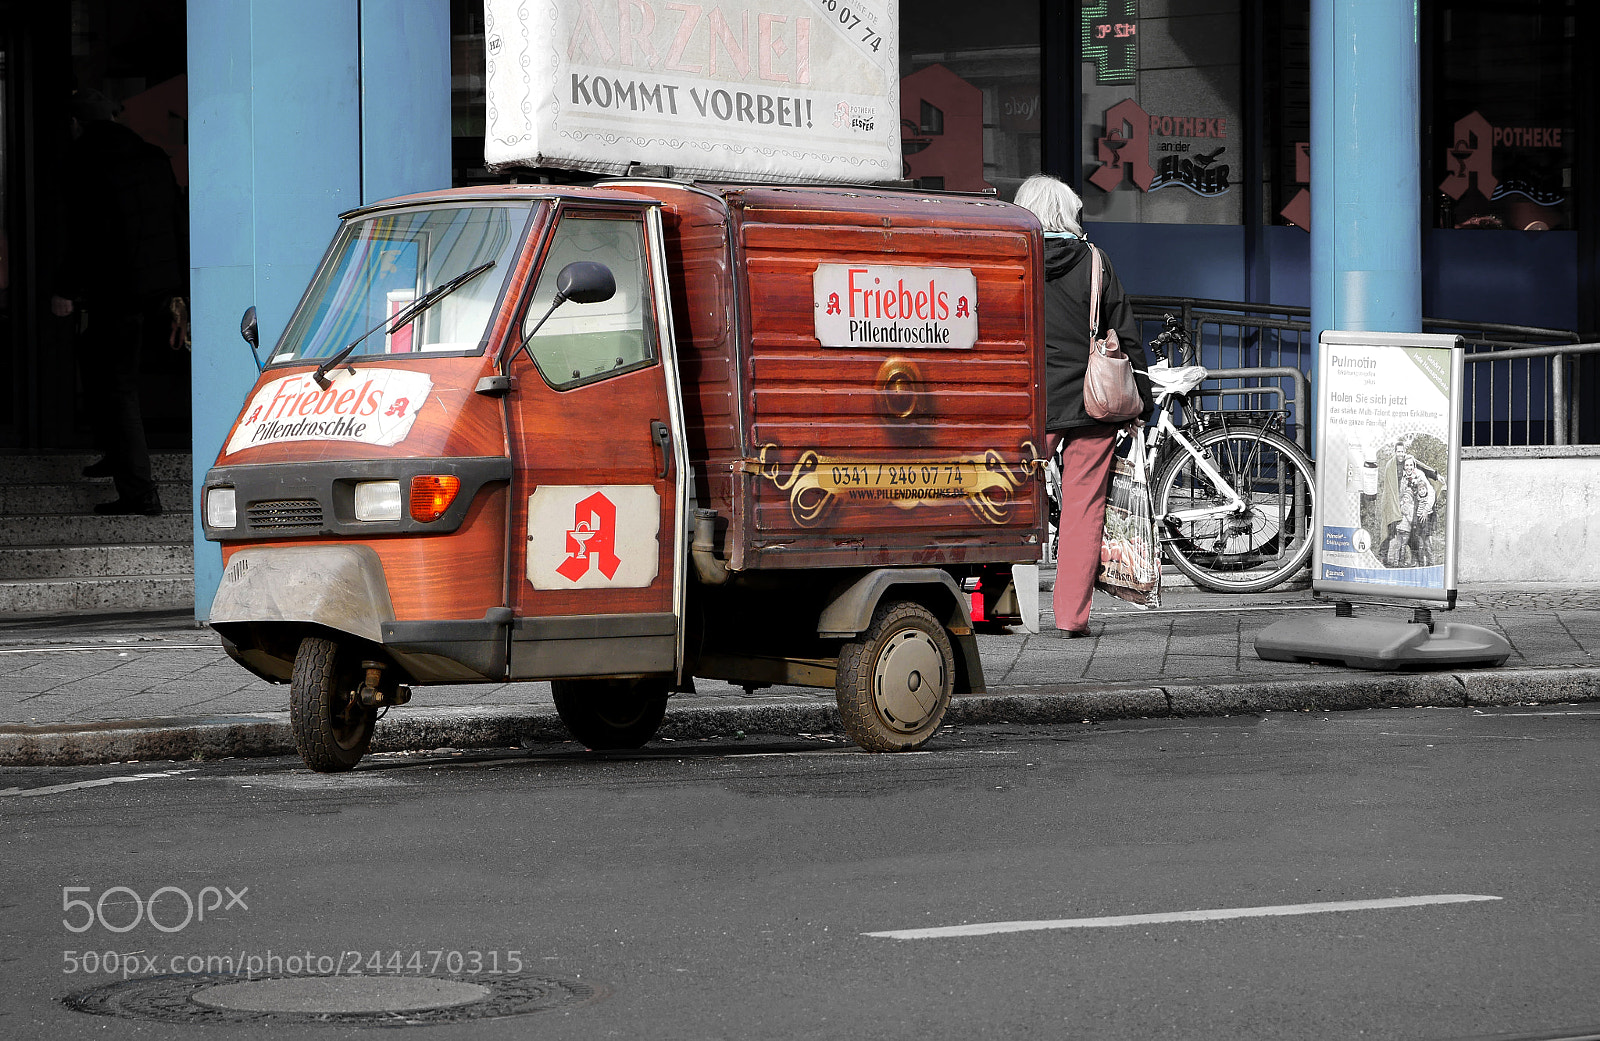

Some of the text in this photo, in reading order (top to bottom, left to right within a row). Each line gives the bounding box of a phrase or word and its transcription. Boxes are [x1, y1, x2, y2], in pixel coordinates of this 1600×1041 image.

[566, 0, 811, 84] ARZNEI
[839, 7, 862, 30] 07
[861, 27, 882, 53] 74
[571, 73, 814, 130] KOMMT VORBEI!
[1161, 141, 1191, 152] an der
[847, 268, 950, 321] Friebels
[849, 320, 950, 344] Pillendroschke
[1331, 355, 1377, 369] Pulmotin
[262, 376, 384, 422] Friebels
[1330, 391, 1408, 406] Holen Sie sich jetzt
[251, 416, 367, 443] Pillendroschke
[832, 465, 870, 486] 0341
[888, 466, 916, 485] 246
[920, 466, 938, 485] 07
[944, 466, 963, 485] 74
